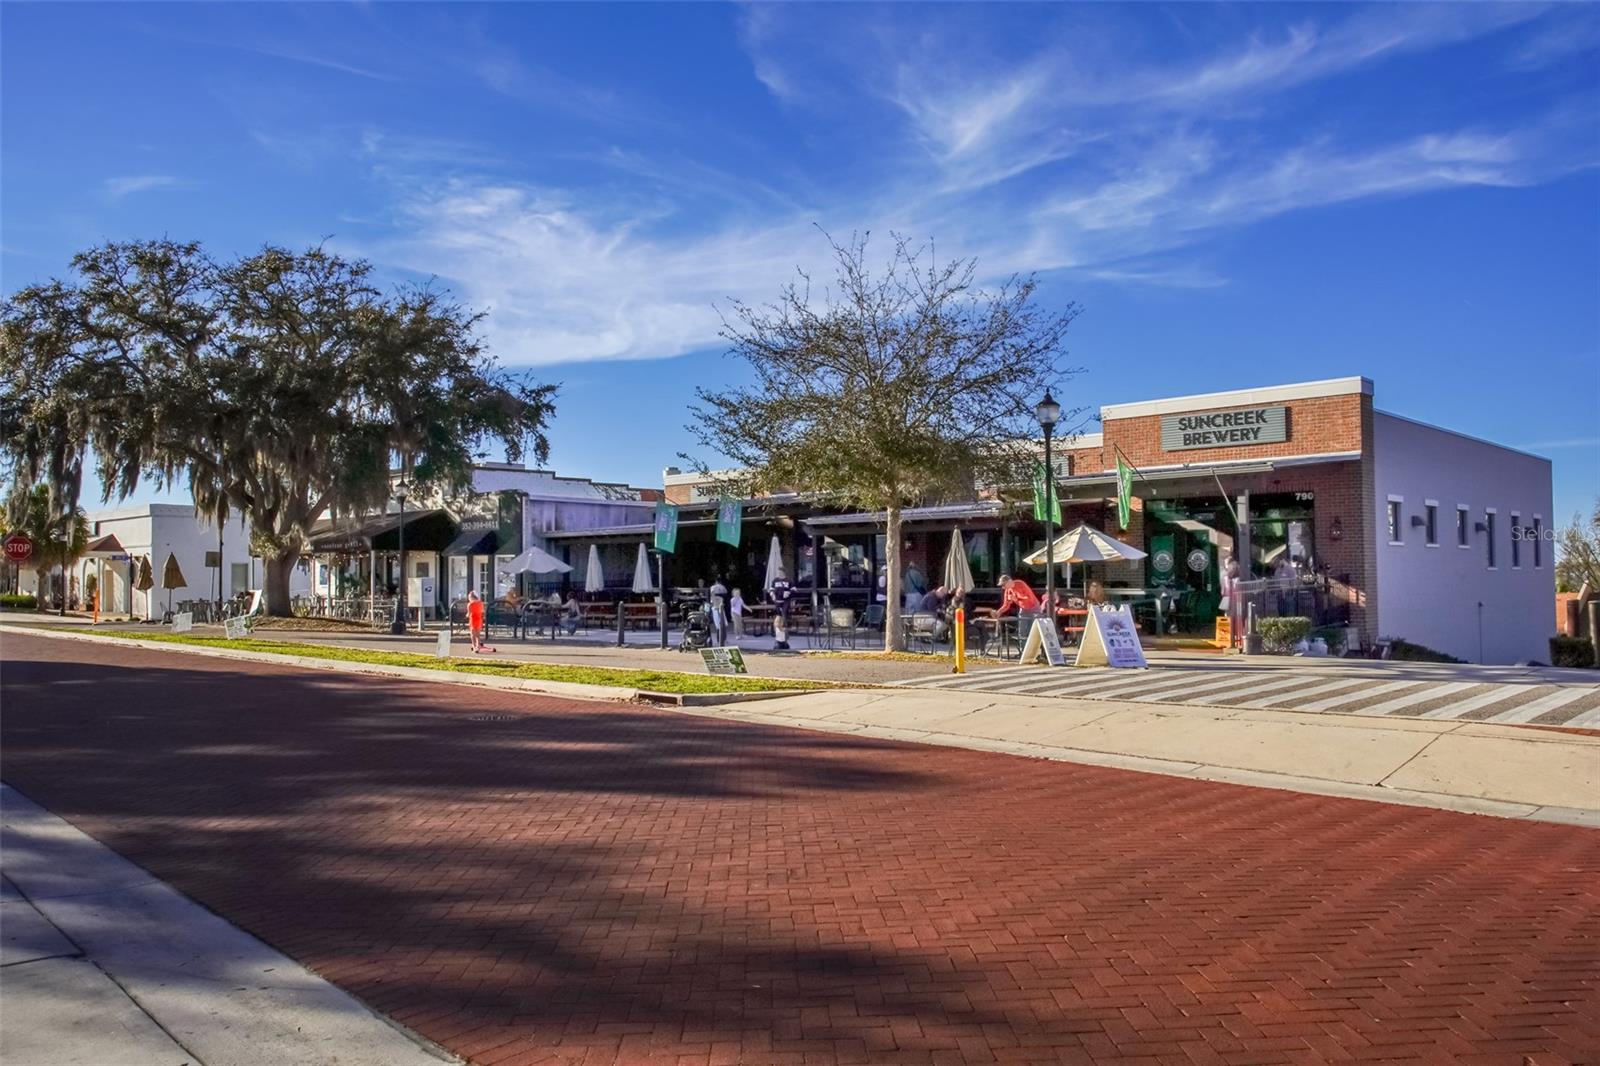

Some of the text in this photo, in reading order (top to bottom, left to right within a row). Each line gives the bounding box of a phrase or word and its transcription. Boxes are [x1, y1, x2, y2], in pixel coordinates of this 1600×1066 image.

[1178, 409, 1267, 431] SUNCREEK
[1182, 426, 1261, 446] BREWERY
[1295, 491, 1314, 501] 790
[7, 543, 30, 553] STOP
